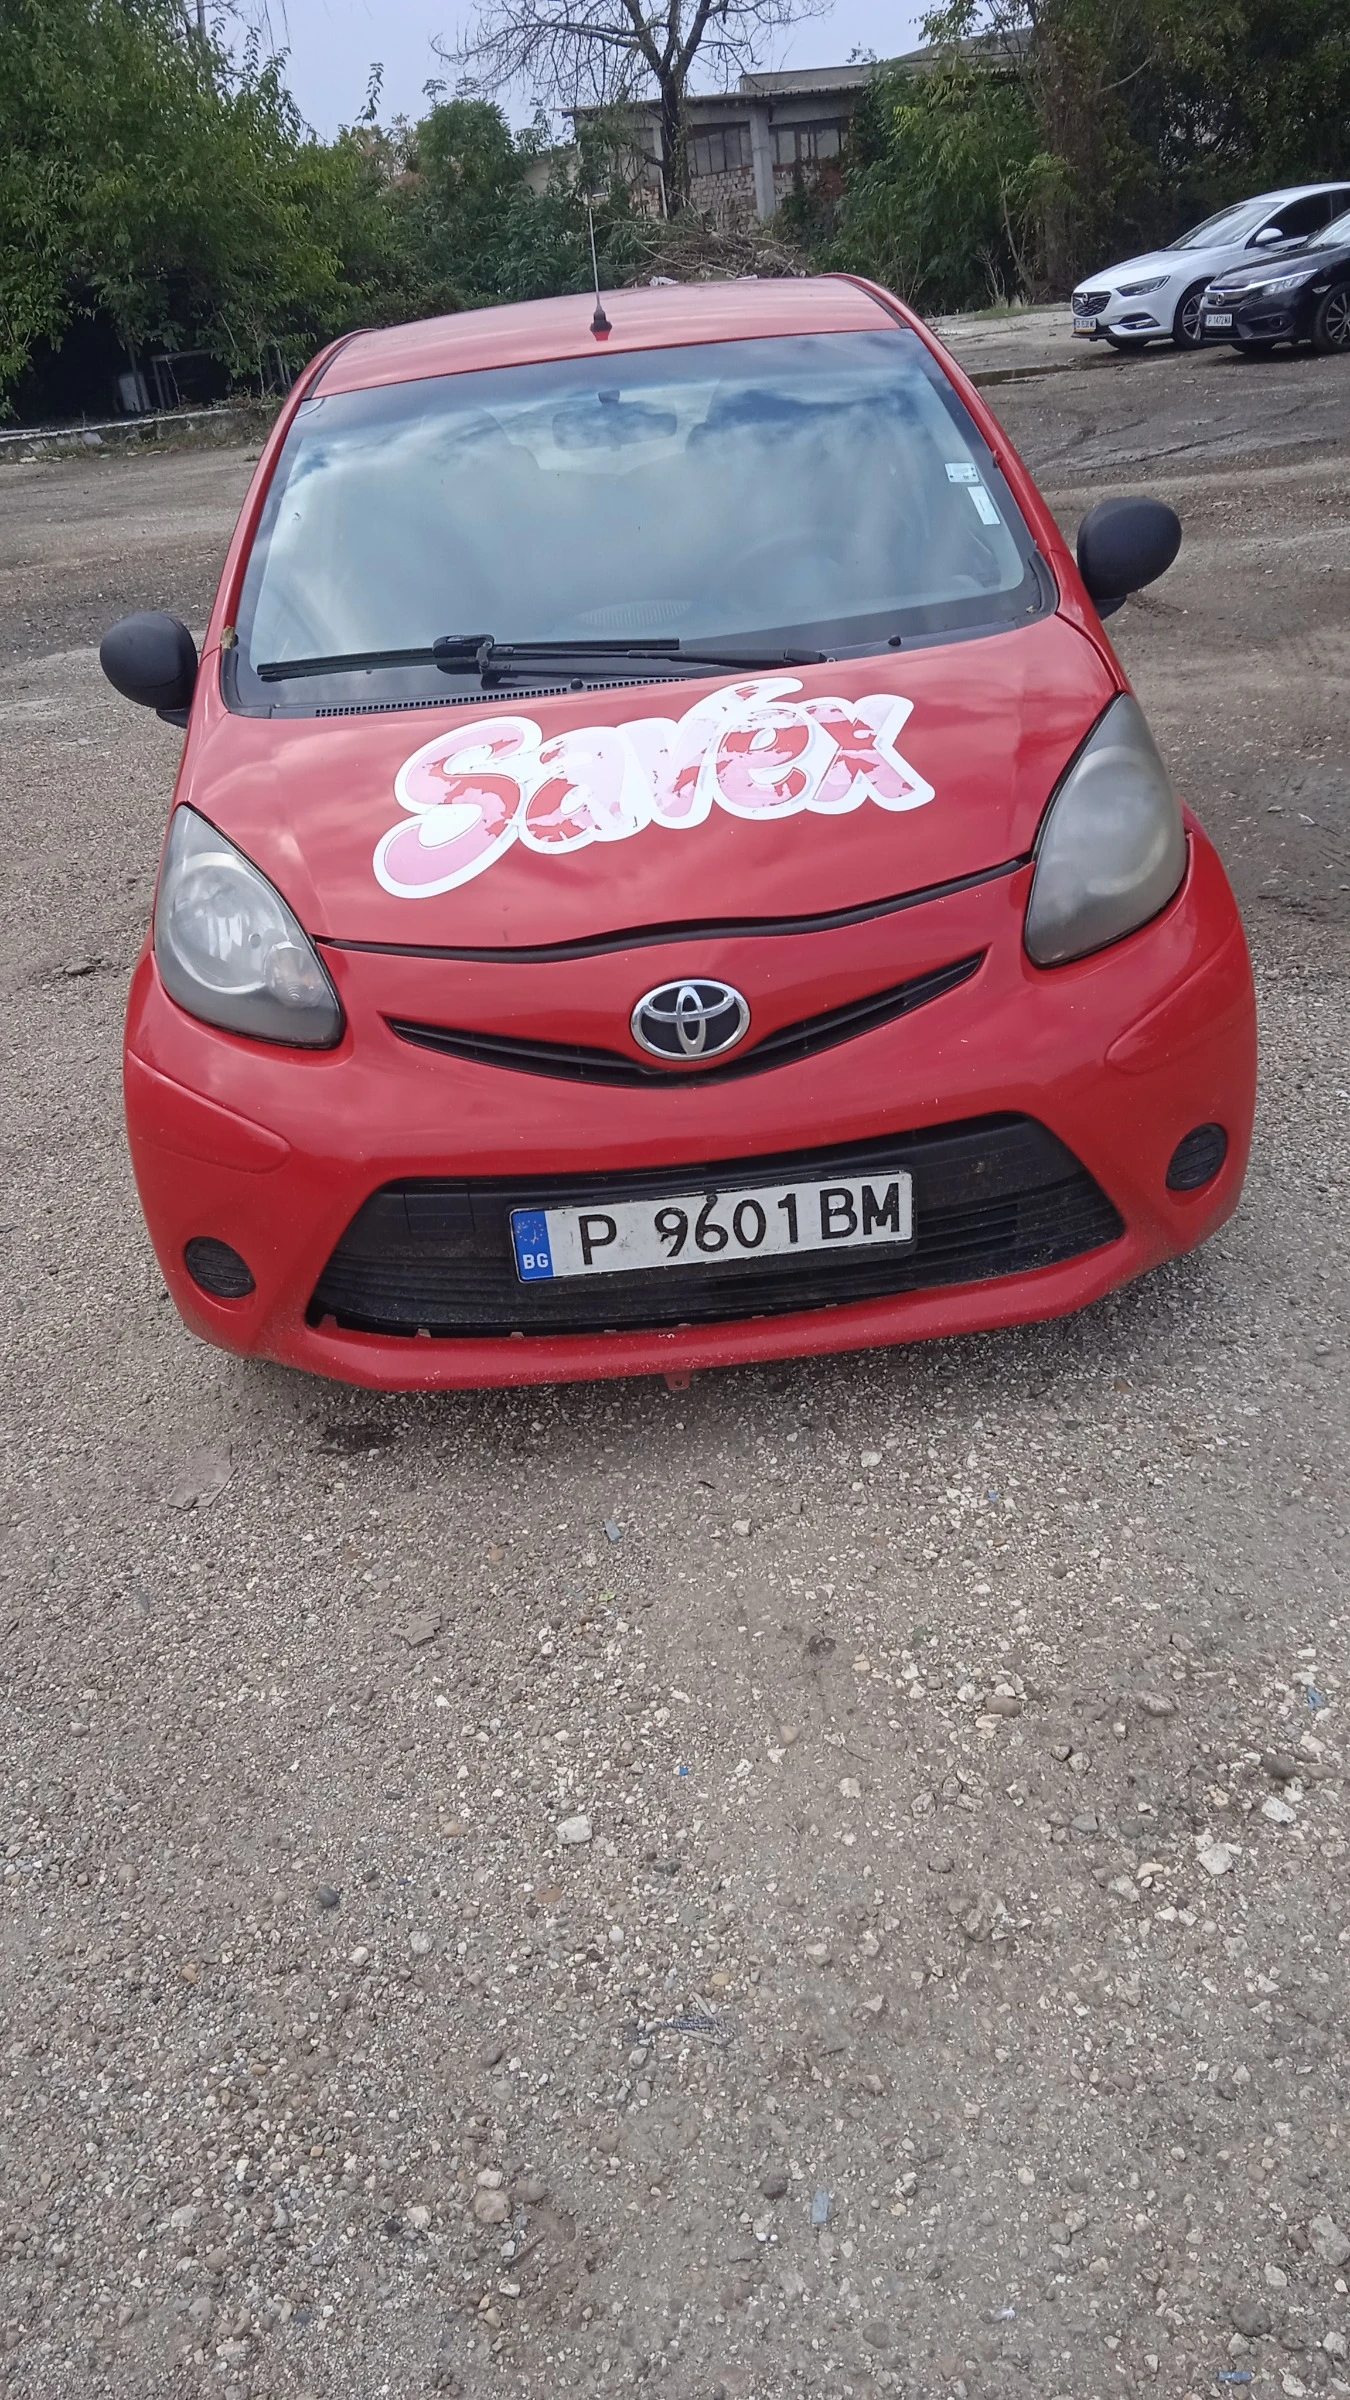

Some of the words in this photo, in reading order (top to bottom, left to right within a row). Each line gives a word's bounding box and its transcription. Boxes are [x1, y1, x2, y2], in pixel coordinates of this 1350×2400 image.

[373, 677, 935, 899] Savex
[522, 1253, 549, 1270] BG
[578, 1214, 617, 1266] P
[653, 1193, 799, 1258] 9601
[819, 1182, 901, 1240] BM
